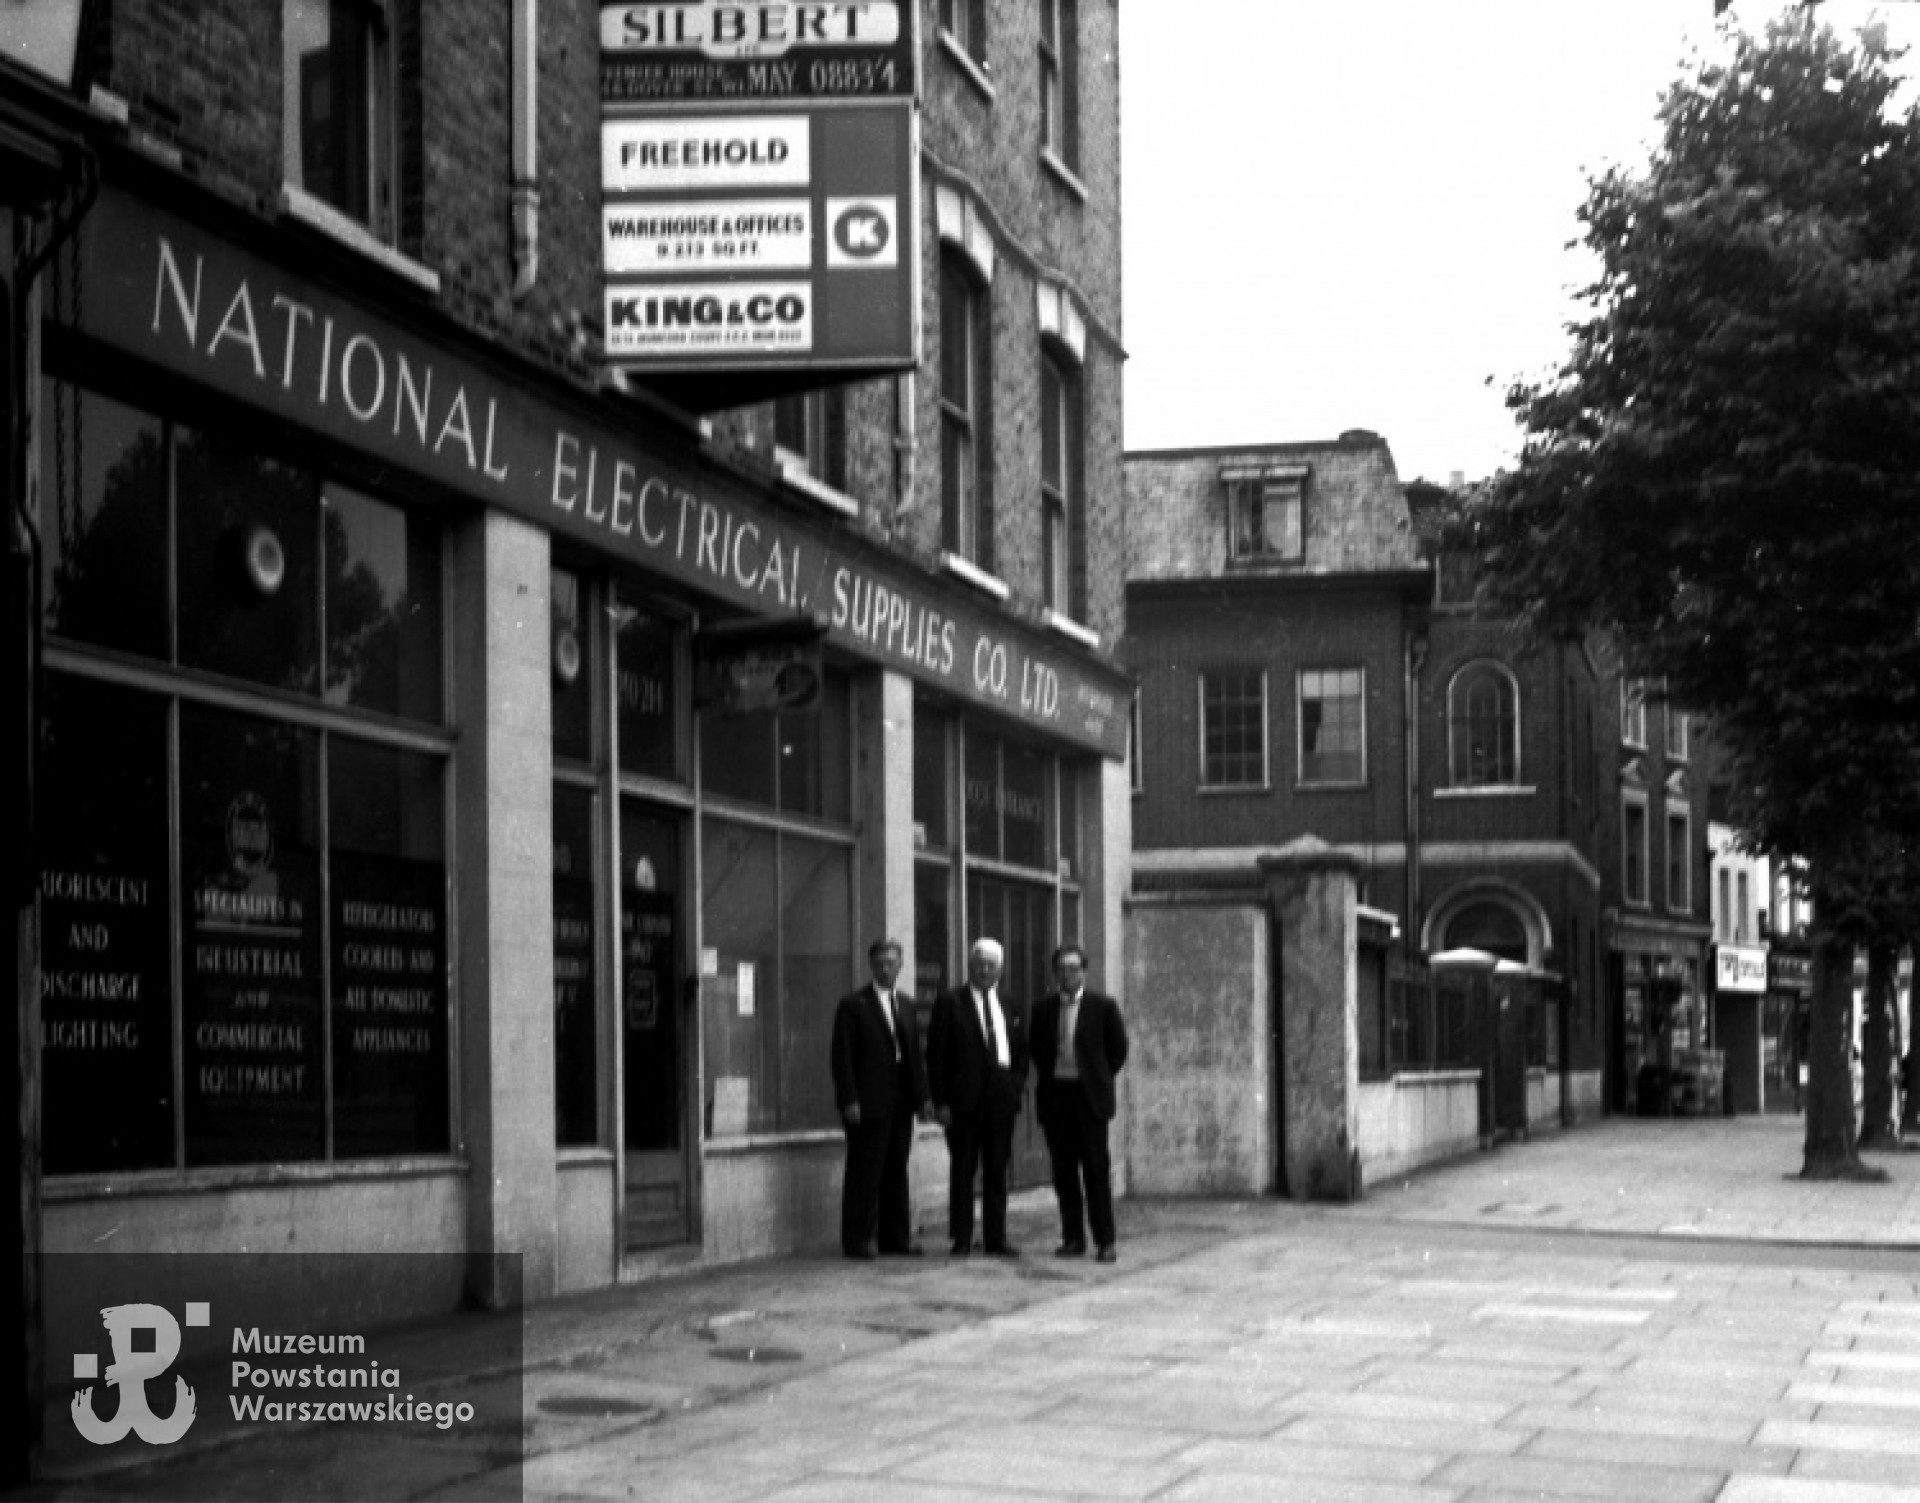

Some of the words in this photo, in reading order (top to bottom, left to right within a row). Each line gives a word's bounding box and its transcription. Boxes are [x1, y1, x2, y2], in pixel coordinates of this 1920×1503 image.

[623, 4, 870, 45] SILBERT
[620, 138, 789, 168] FREEHOLD
[151, 234, 508, 482] NATIONAL
[551, 430, 806, 608] ELECTRICAL
[831, 566, 957, 675] SUPPLIES
[973, 633, 1007, 697] CO.
[1020, 657, 1061, 719] LTD.
[68, 922, 110, 951] AND
[196, 944, 303, 979] INDUSTRIAL
[196, 1020, 303, 1052] COMMERCIAL
[199, 1064, 306, 1095] EQUIPMENT
